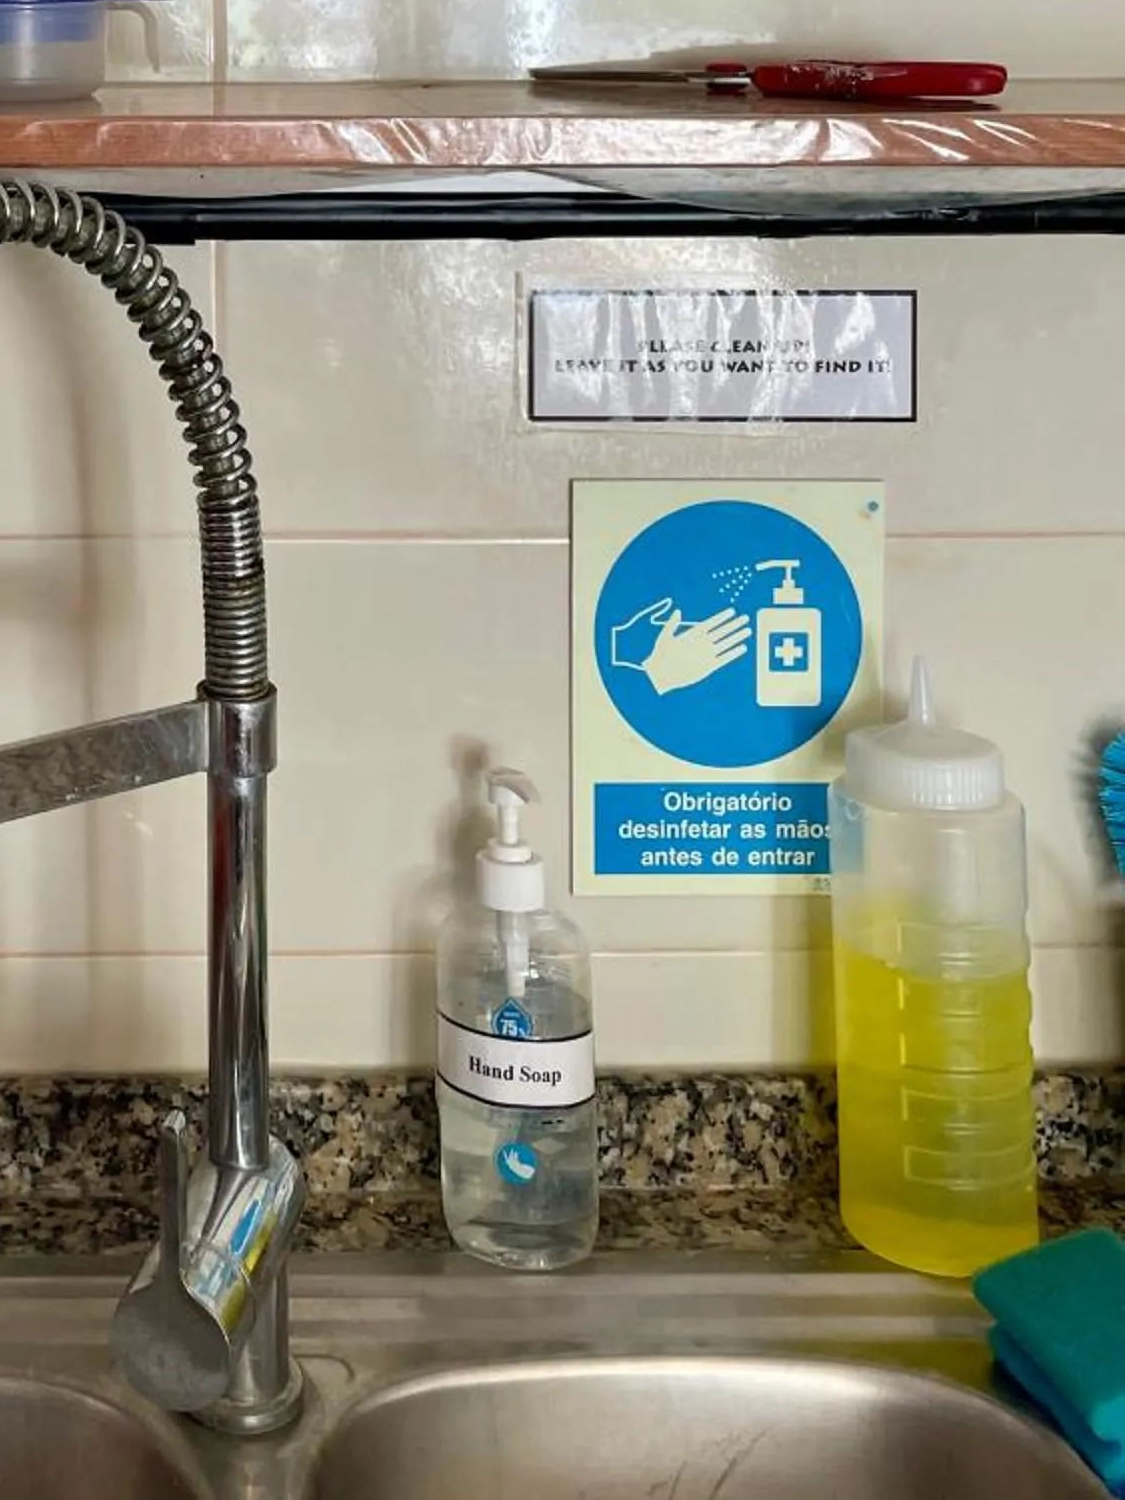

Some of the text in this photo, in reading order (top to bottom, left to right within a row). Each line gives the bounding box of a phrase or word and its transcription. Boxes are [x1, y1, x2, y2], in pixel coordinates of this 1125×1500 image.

[710, 339, 769, 353] CEAN
[554, 359, 615, 373] LEAVE
[619, 359, 638, 373] IT
[645, 359, 666, 373] AS
[673, 359, 714, 373] YOU
[720, 359, 776, 373] WANT
[782, 359, 809, 373] TO
[815, 359, 862, 373] FIND
[663, 790, 793, 816] Obrigatório
[618, 819, 732, 839] desinfetar
[739, 823, 767, 839] as
[640, 847, 815, 866] antes de entrar
[469, 1055, 562, 1087] Hand Soap
